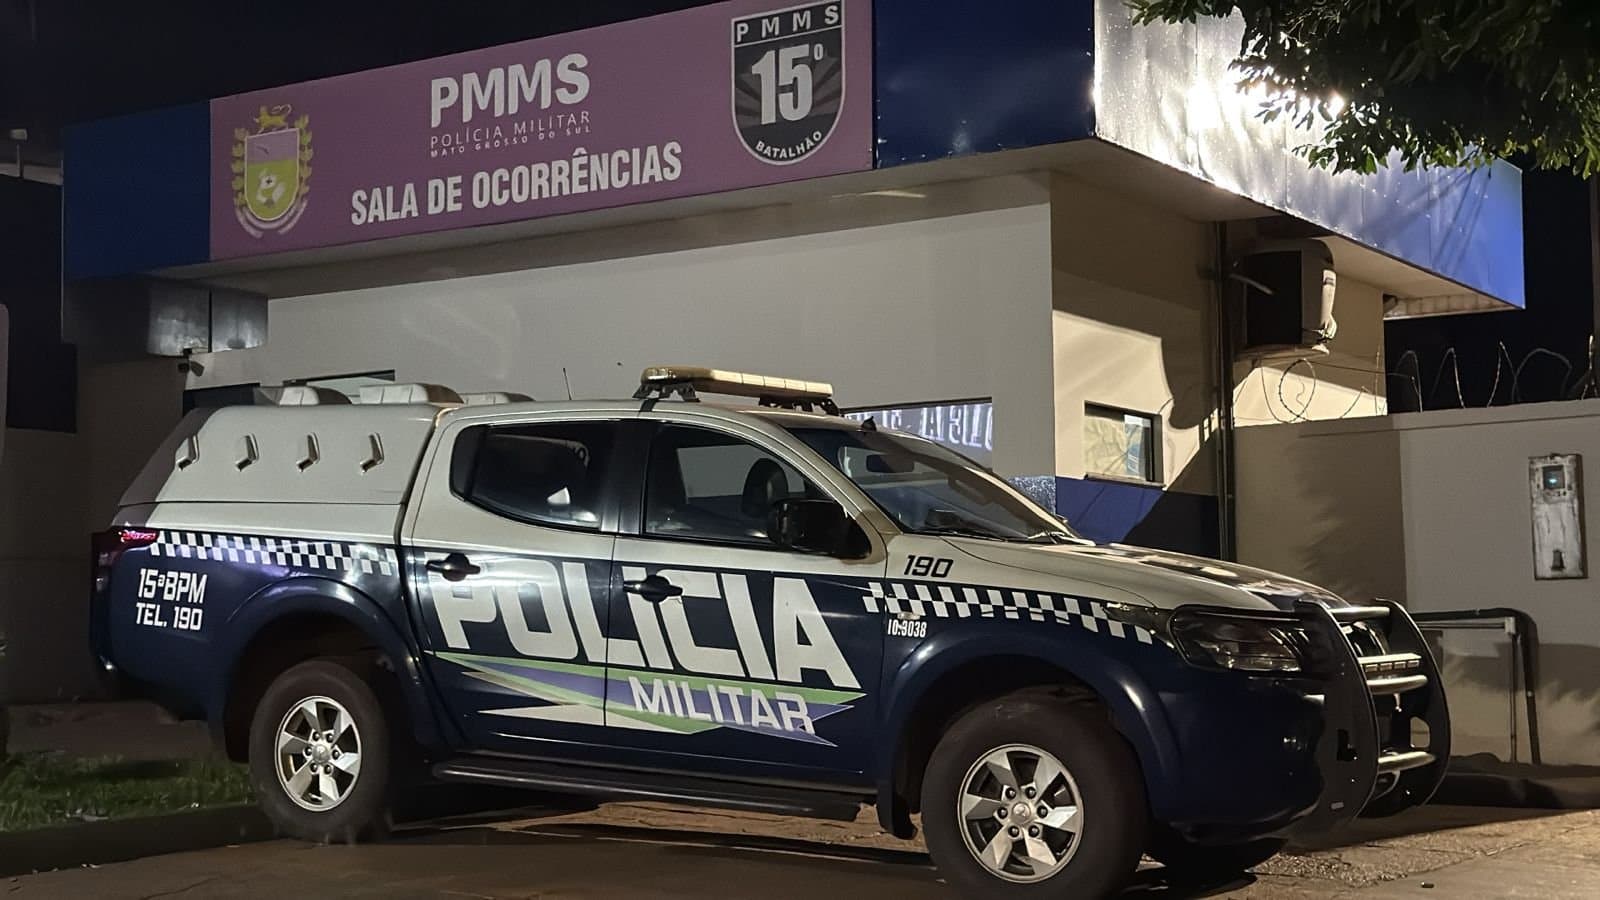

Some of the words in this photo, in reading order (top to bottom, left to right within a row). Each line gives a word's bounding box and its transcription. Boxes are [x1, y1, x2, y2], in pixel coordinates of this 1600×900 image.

[431, 53, 590, 128] PMMS
[431, 126, 503, 149] POLÍCIA
[514, 111, 590, 135] MILITAR
[431, 145, 465, 158] MATO
[475, 136, 528, 151] GROSSO
[538, 131, 556, 141] DO
[566, 125, 590, 136] SUL
[755, 131, 822, 159] BATALHÃO
[351, 183, 418, 226] SALA
[427, 175, 462, 215] DE
[472, 141, 682, 209] OCORRÊNCIAS
[904, 555, 954, 578] 190
[136, 602, 167, 628] TEL.
[173, 606, 203, 631] 190
[628, 676, 816, 735] MILITAR
